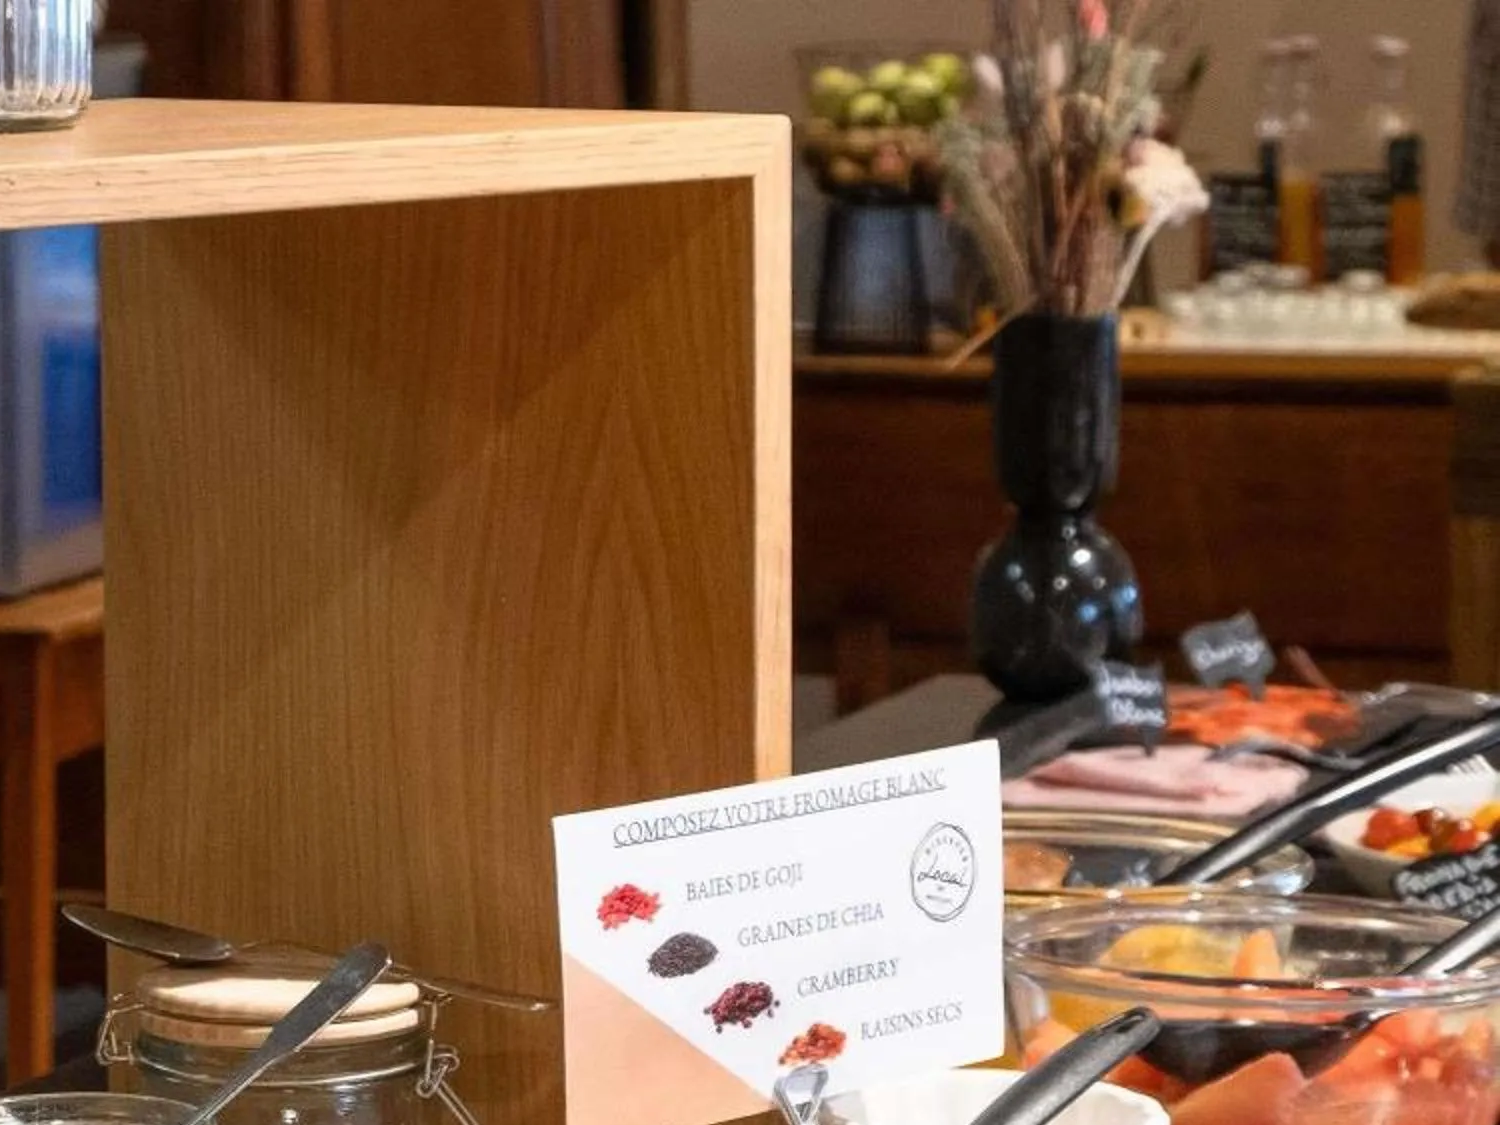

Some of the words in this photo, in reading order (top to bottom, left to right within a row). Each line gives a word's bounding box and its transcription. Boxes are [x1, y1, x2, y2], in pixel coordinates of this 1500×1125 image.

[612, 807, 721, 848] COMPOSEZ
[724, 797, 790, 828] VOTRE
[793, 778, 882, 817] FROMAGE
[886, 767, 948, 800] BLANC
[686, 873, 733, 902] BAIES
[736, 869, 761, 894] DE
[764, 863, 803, 889] GOJI
[737, 916, 814, 948] GRAINES
[816, 912, 839, 935] DE
[841, 902, 884, 930] CHIA
[796, 957, 900, 998] CRAMBERRY
[860, 1008, 924, 1041] RAISINS
[925, 1001, 964, 1028] SECS
